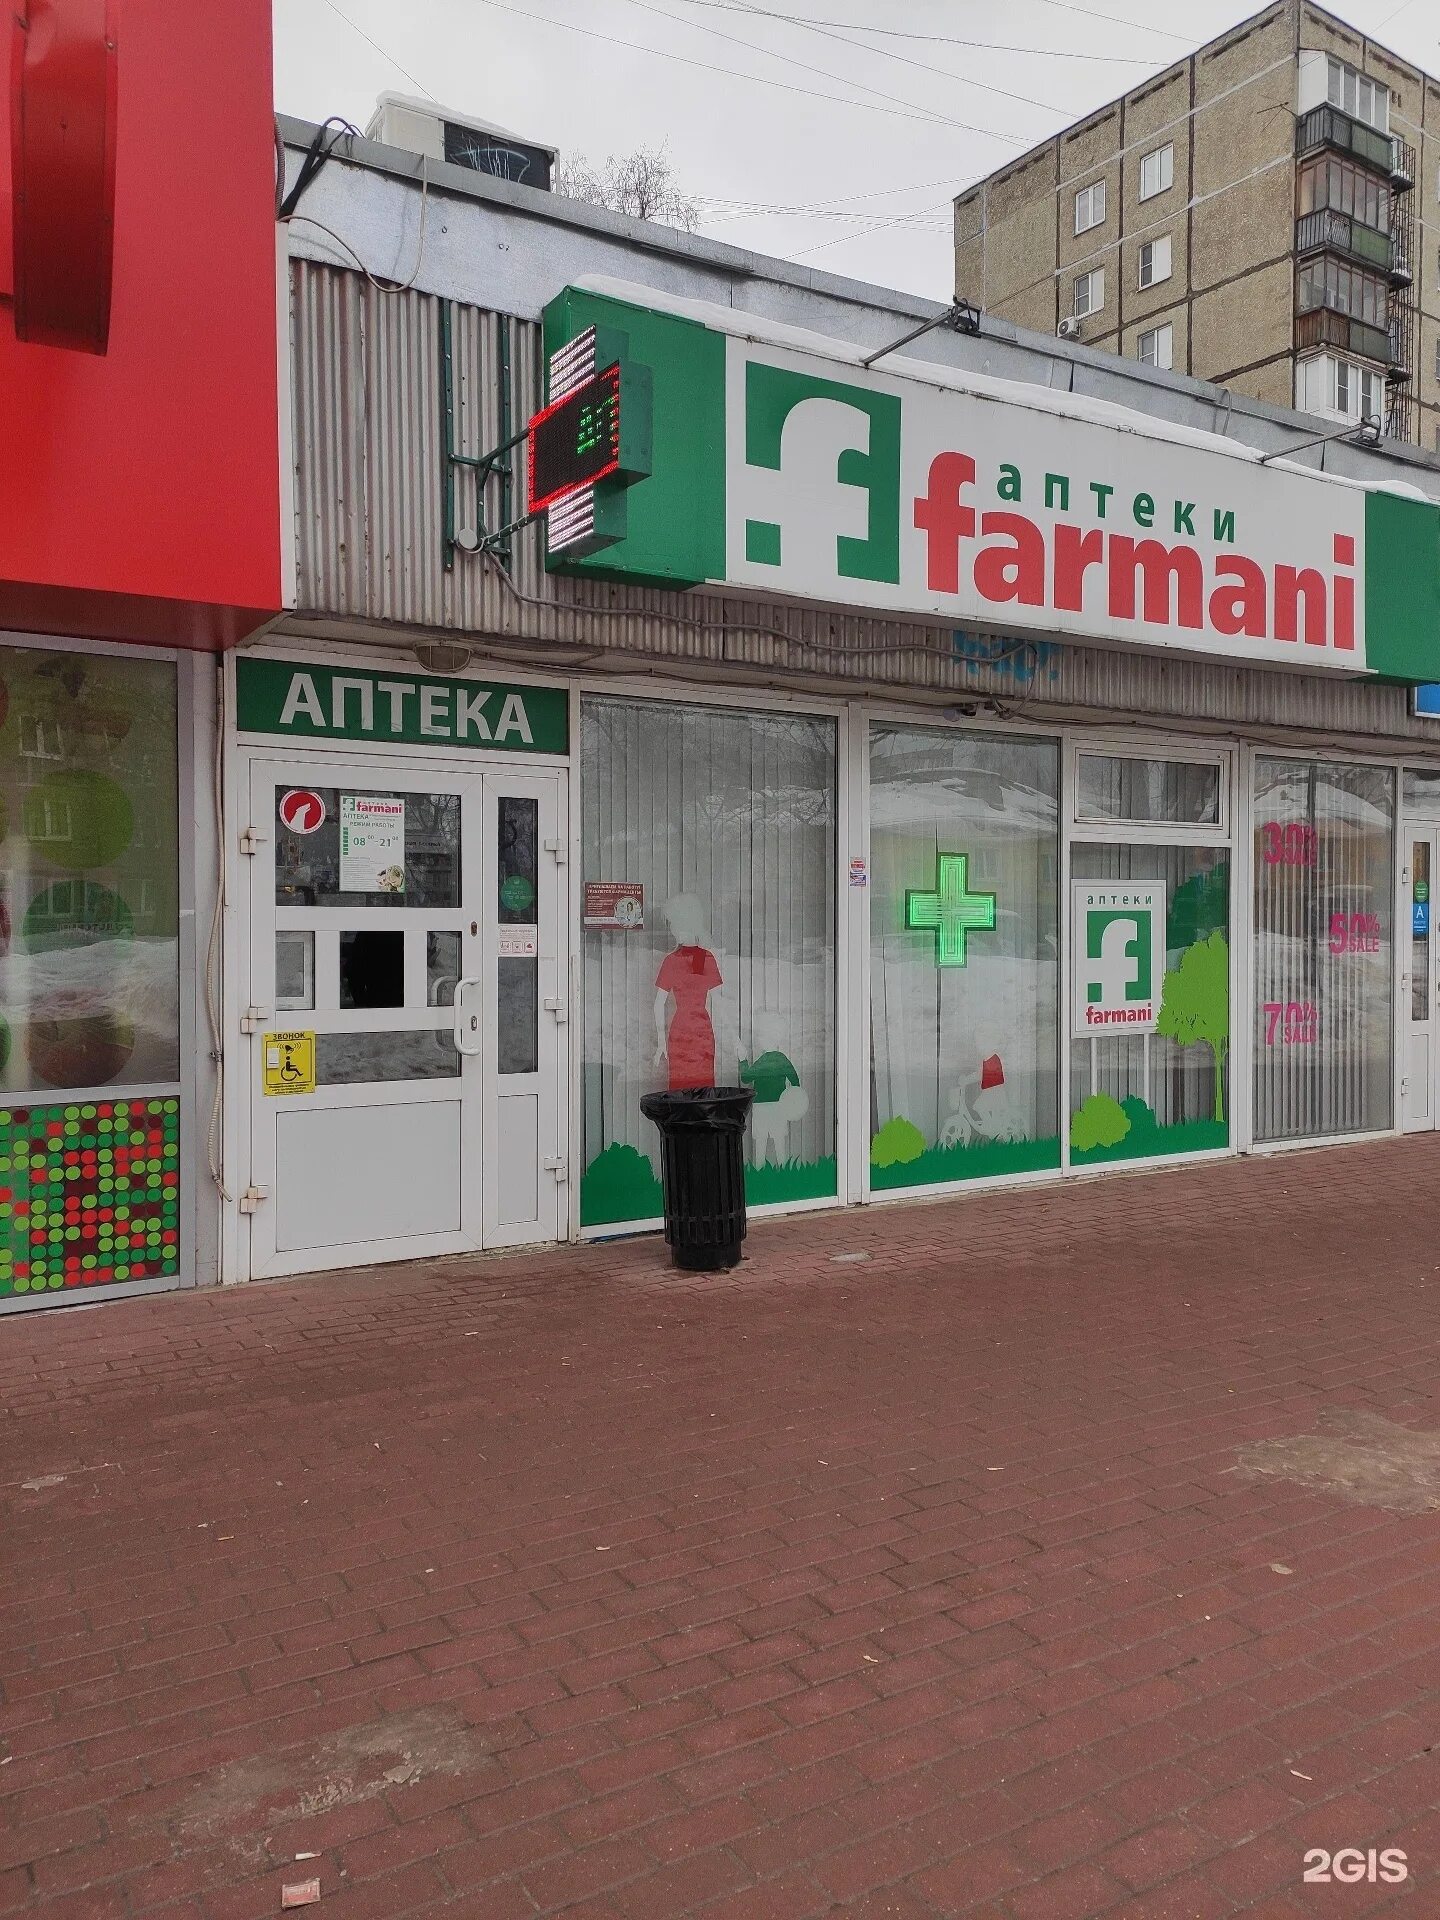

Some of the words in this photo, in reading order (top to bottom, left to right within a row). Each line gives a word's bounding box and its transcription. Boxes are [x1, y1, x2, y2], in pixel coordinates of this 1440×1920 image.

[996, 463, 1236, 544] аптеки
[913, 451, 1355, 651] farmani
[279, 672, 534, 744] АПТЕКА
[356, 801, 402, 813] farmani
[353, 837, 366, 846] 08
[1087, 895, 1152, 905] аптеки
[1329, 912, 1380, 954] 50%
[1349, 937, 1380, 953] SALE
[1086, 1002, 1152, 1025] farmani
[272, 1032, 306, 1040] ЗВОНОК
